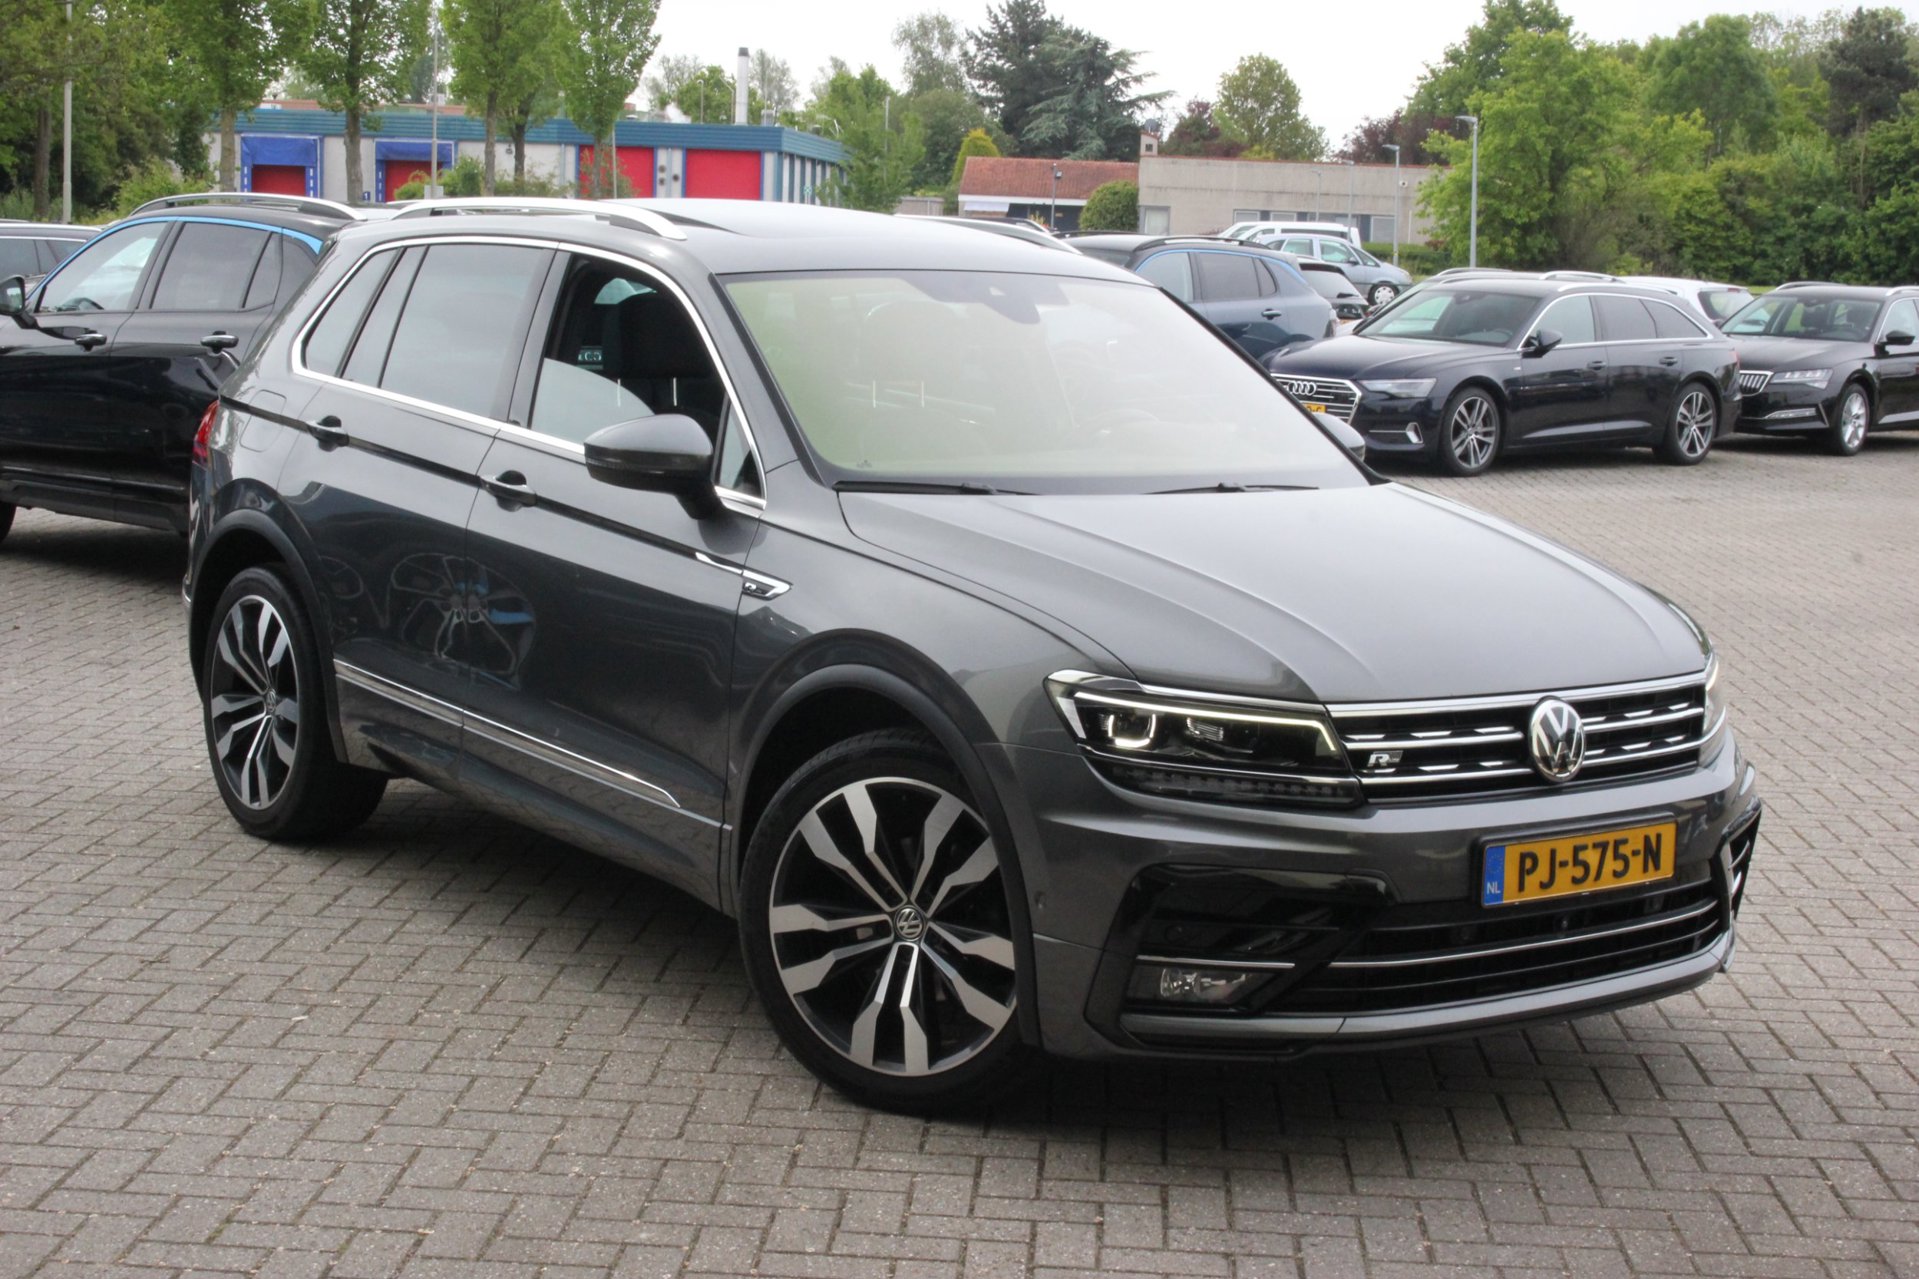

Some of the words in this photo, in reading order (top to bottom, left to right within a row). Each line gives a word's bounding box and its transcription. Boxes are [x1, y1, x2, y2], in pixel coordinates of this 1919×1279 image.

[1367, 753, 1390, 767] R
[1518, 832, 1662, 893] PJ-575-N
[1487, 881, 1501, 894] NL
